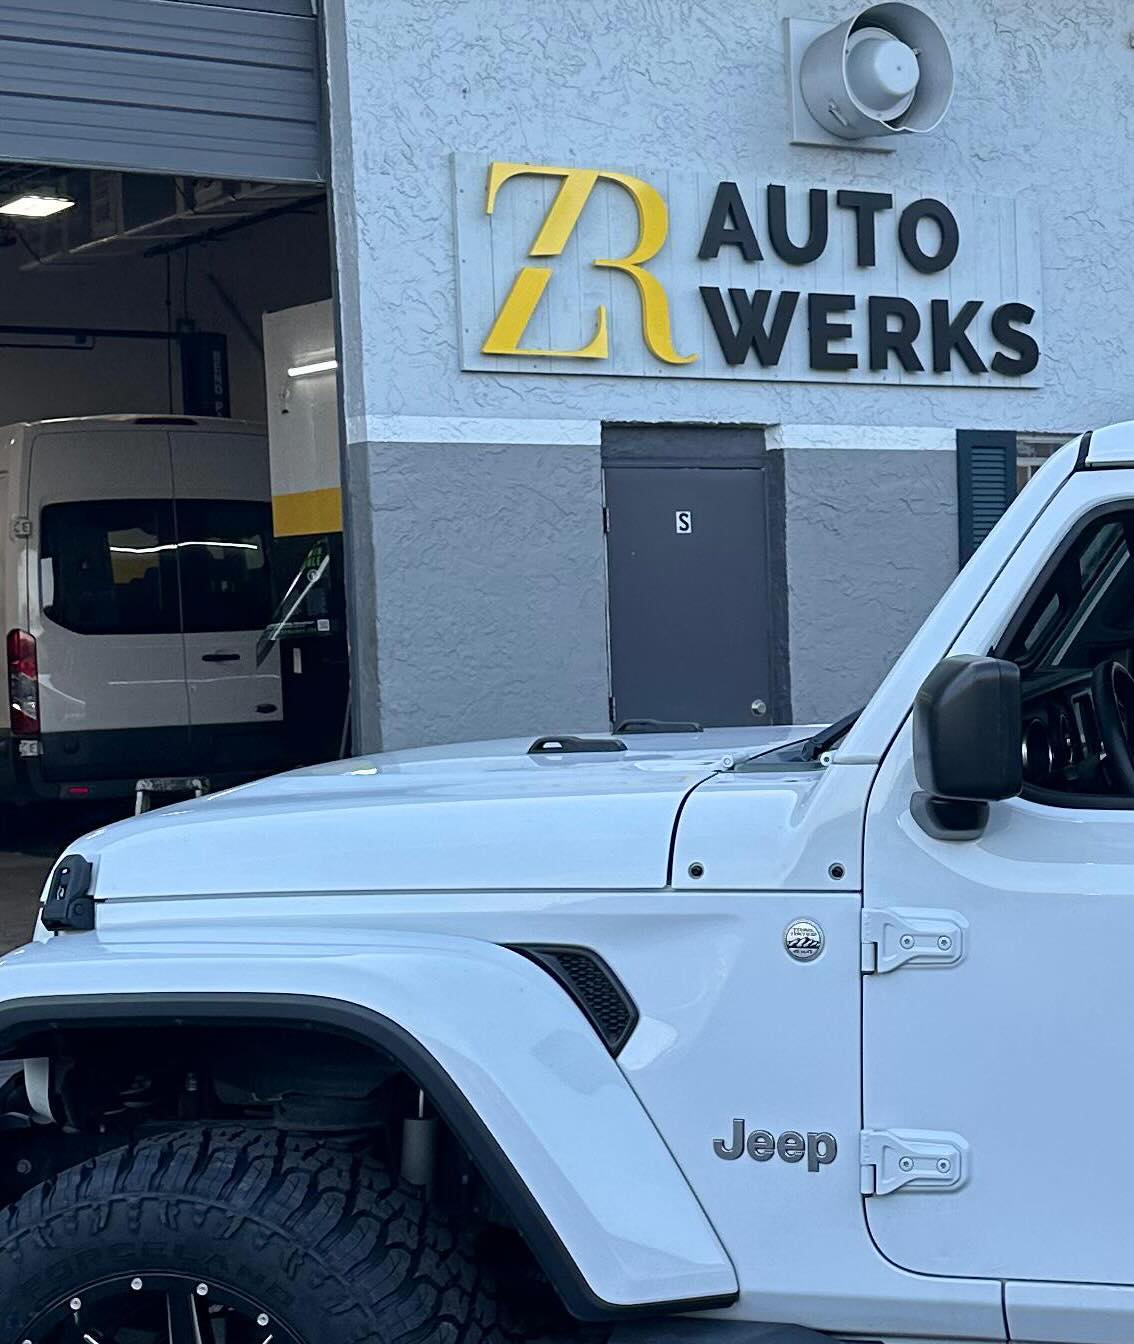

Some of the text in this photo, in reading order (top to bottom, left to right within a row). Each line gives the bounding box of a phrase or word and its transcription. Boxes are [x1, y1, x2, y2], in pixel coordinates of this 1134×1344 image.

[481, 162, 698, 364] ZR
[699, 181, 960, 273] AUTO
[700, 286, 1040, 376] WERKS
[679, 513, 690, 531] S
[713, 1118, 838, 1172] Jeep
